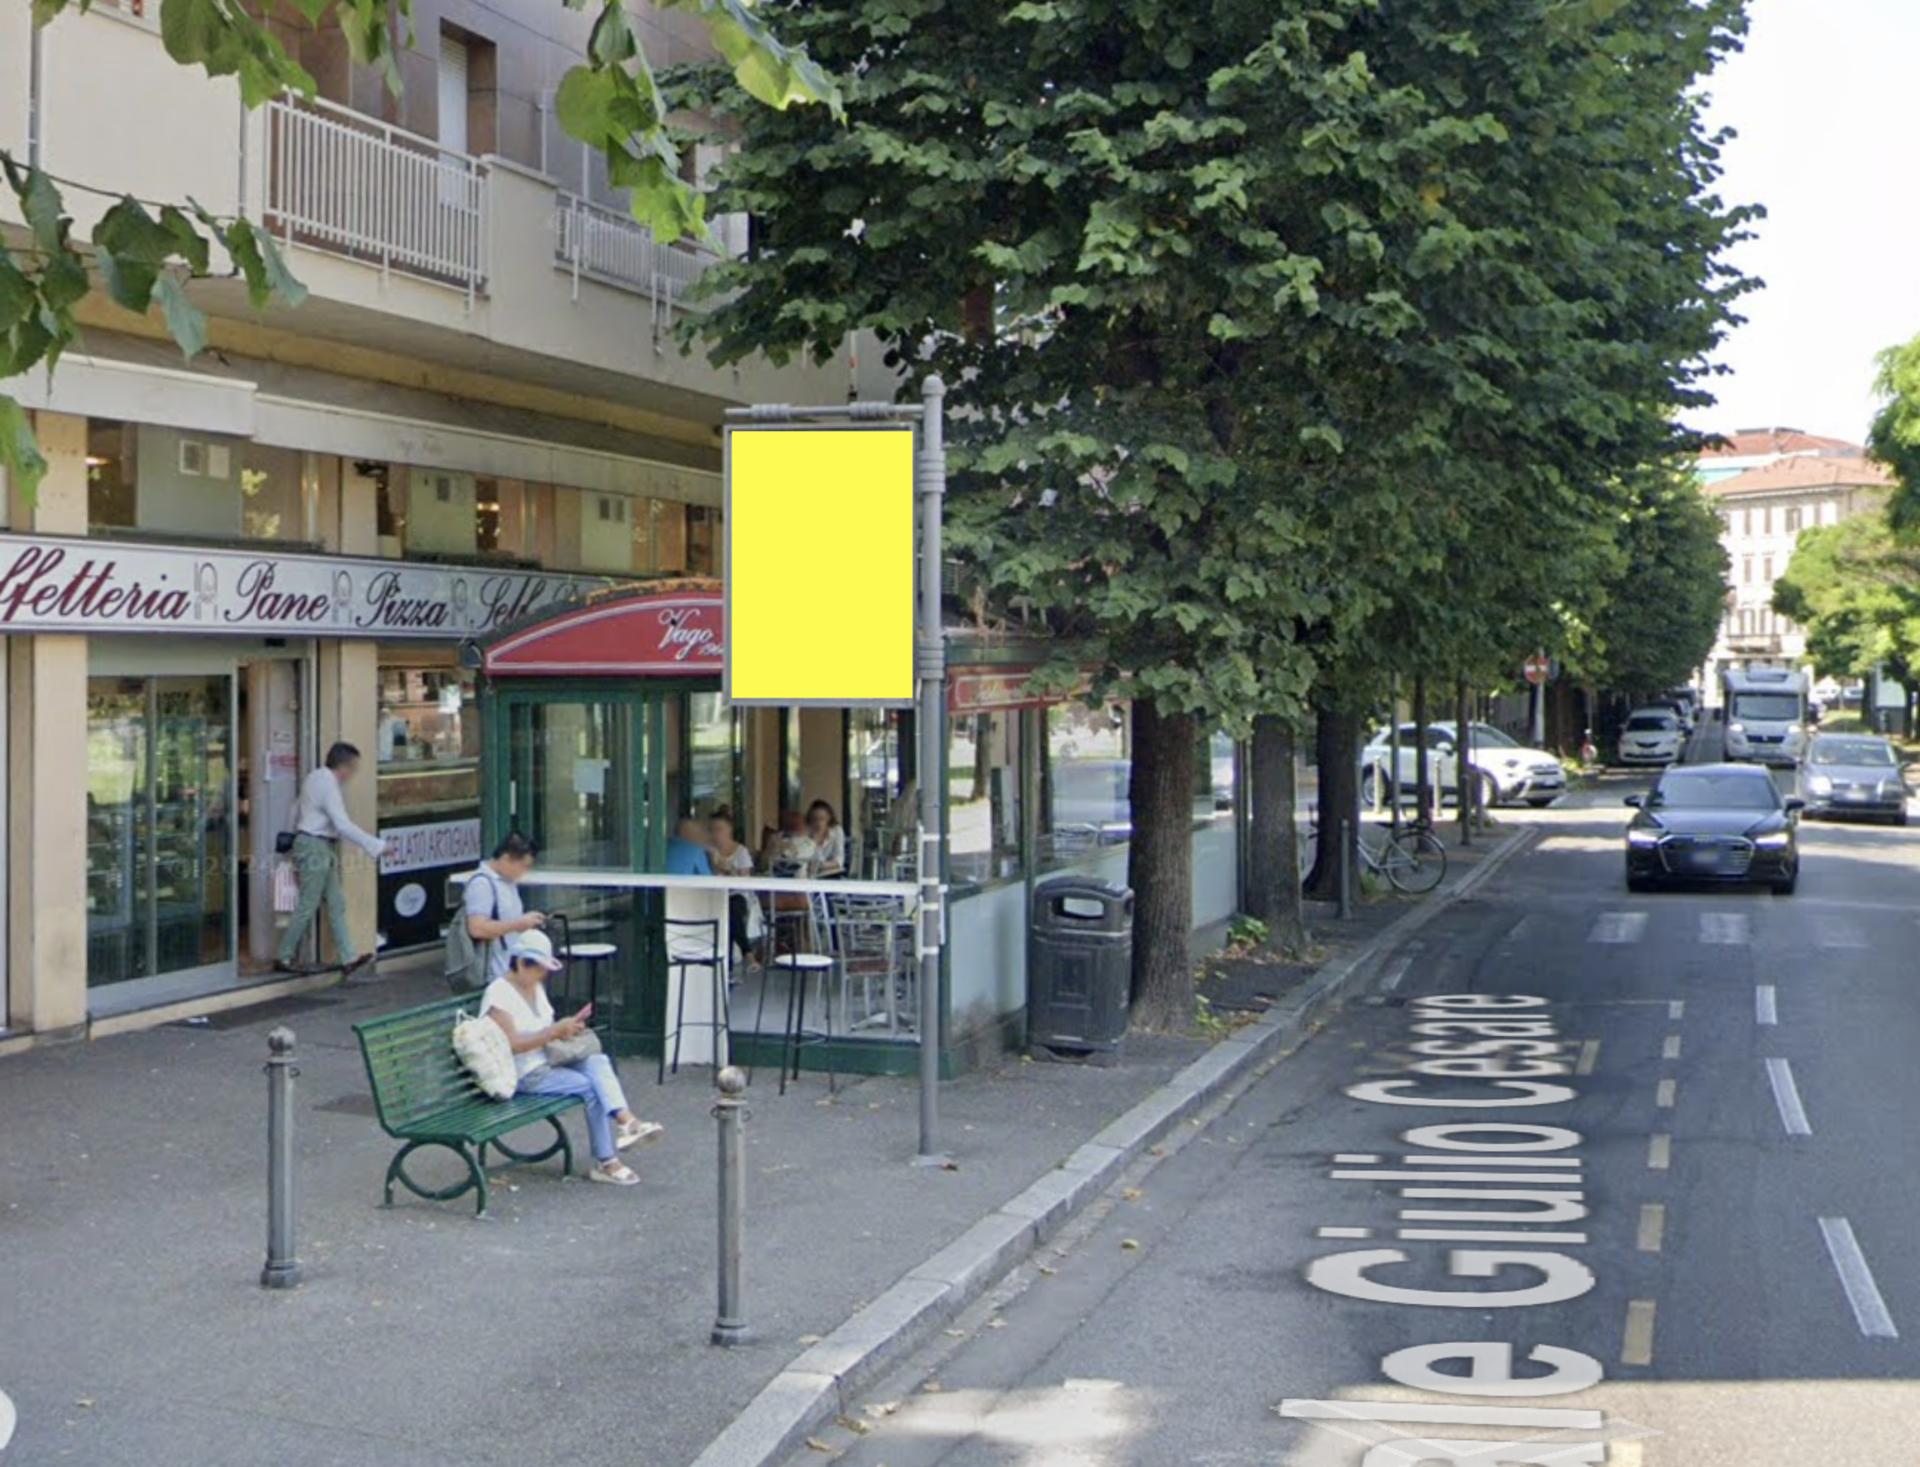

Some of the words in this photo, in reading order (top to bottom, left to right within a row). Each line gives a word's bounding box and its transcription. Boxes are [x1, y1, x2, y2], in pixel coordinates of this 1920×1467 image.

[224, 559, 331, 622] Pane
[355, 570, 450, 628] Pizza
[658, 607, 714, 660] Vago
